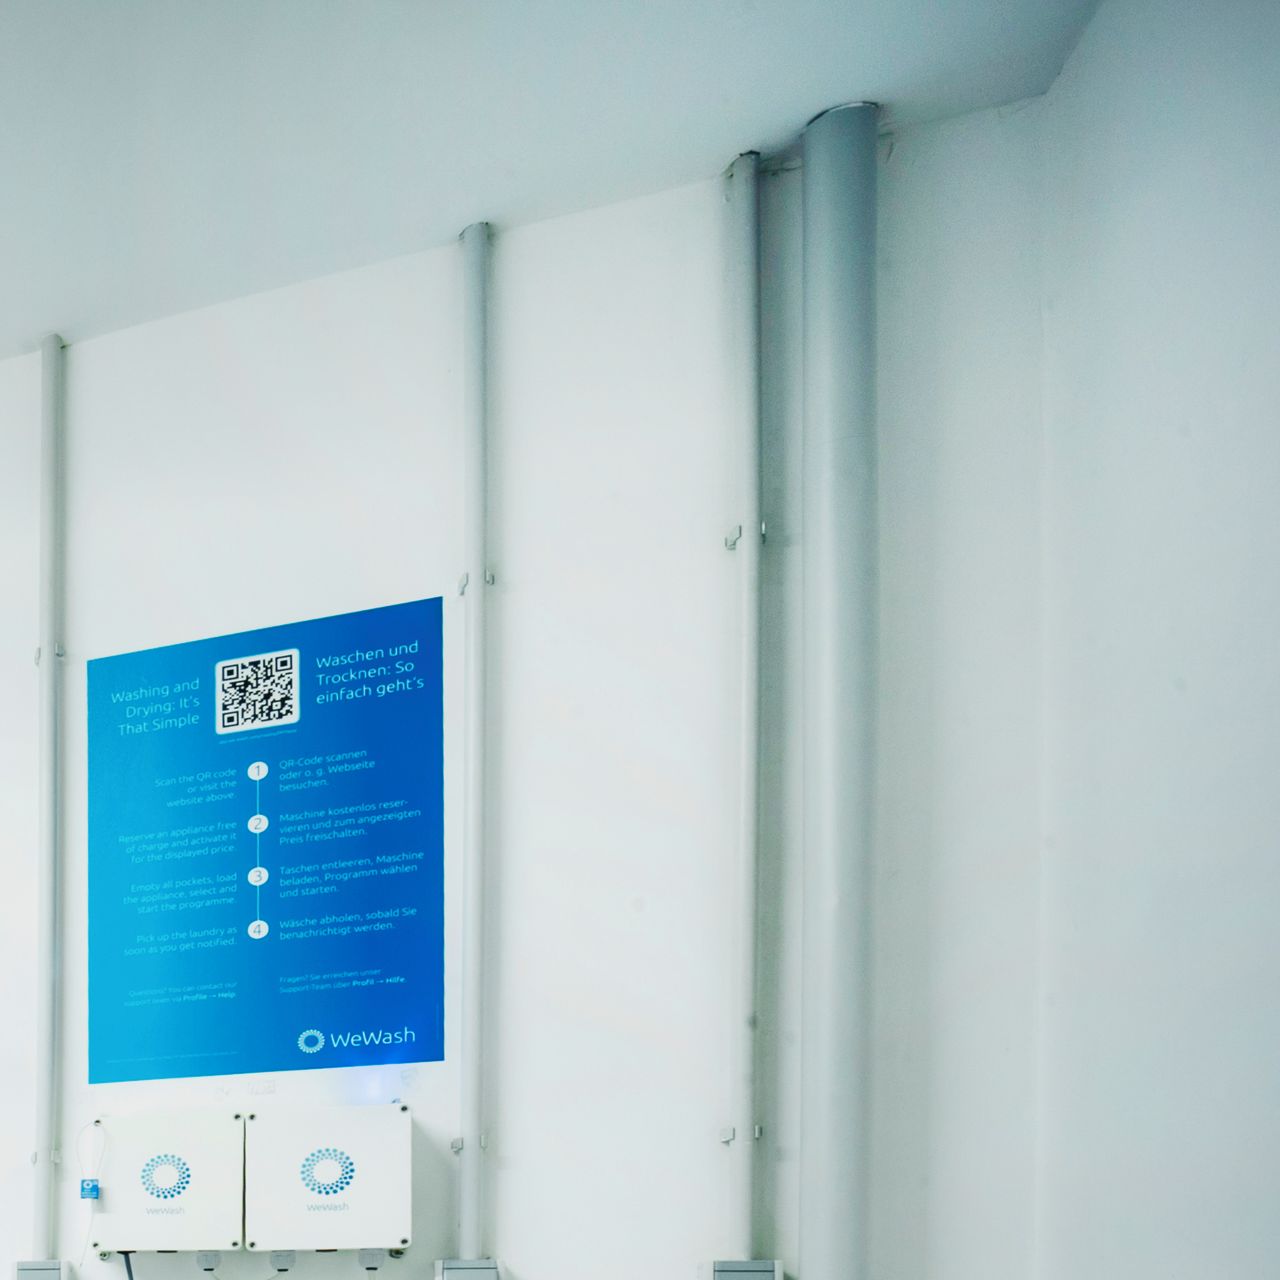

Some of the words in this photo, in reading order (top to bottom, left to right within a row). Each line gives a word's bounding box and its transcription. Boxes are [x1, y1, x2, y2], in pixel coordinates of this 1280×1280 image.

[316, 650, 384, 668] Waschen
[389, 640, 418, 656] und
[316, 666, 391, 686] Trocknen:
[396, 660, 414, 674] So
[111, 686, 169, 704] Washing
[174, 677, 200, 693] and
[316, 685, 372, 704] einfach
[126, 702, 176, 718] Drying:
[180, 696, 200, 709] It's
[117, 722, 148, 736] That
[152, 714, 200, 731] Simple
[279, 755, 323, 770] QR-Code
[326, 750, 367, 763] scannen
[154, 776, 176, 787] Scan
[178, 774, 194, 783] the
[196, 771, 212, 781] QR
[213, 768, 237, 778] code
[254, 765, 260, 776] 1
[280, 770, 302, 780] oder
[316, 768, 326, 776] g.
[328, 760, 375, 774] Webseite
[199, 782, 218, 792] visit
[220, 779, 237, 788] the
[279, 779, 328, 792] besuchen.
[166, 796, 204, 807] website
[205, 792, 237, 802] above.
[279, 809, 326, 822] Maschine
[328, 802, 376, 815] kostenlos
[378, 800, 408, 809] reser-
[254, 818, 262, 830] 2
[279, 822, 309, 834] vieren
[312, 819, 331, 830] und
[334, 818, 355, 827] zum
[357, 810, 421, 825] angezeigten
[118, 832, 156, 843] Reserve
[157, 830, 168, 838] an
[170, 825, 215, 838] appliance
[217, 821, 237, 829] free
[279, 834, 303, 845] Preis
[306, 827, 368, 842] freischalten.
[126, 845, 135, 854] of
[138, 840, 169, 853] charge
[171, 836, 188, 847] and
[191, 833, 227, 845] activate
[230, 832, 237, 840] it
[130, 855, 144, 863] for
[147, 852, 163, 861] the
[165, 846, 208, 860] displayed
[211, 844, 237, 856] price.
[280, 862, 319, 875] Taschen
[376, 851, 424, 864] Maschine
[254, 871, 262, 882] 3
[324, 869, 378, 882] Programm
[380, 863, 417, 875] wählen
[130, 883, 160, 894] Empty
[163, 880, 173, 889] all
[175, 875, 214, 889] pockets,
[216, 873, 237, 882] load
[280, 888, 298, 898] und
[123, 896, 137, 904] the
[190, 887, 216, 899] select
[219, 884, 237, 894] and
[138, 905, 158, 914] start
[161, 902, 177, 911] the
[179, 898, 237, 911] programme.
[280, 916, 317, 929] Wäsche
[366, 907, 399, 920] sobald
[401, 907, 417, 916] Sie
[136, 934, 155, 943] Pick
[157, 933, 169, 942] up
[171, 931, 187, 940] the
[190, 927, 225, 939] laundry
[253, 924, 261, 935] 4
[280, 925, 351, 940] benachrichtigt
[124, 948, 146, 956] soon
[160, 944, 177, 954] you
[179, 941, 194, 951] get
[197, 937, 237, 949] notified.
[331, 1026, 415, 1047] WeWash
